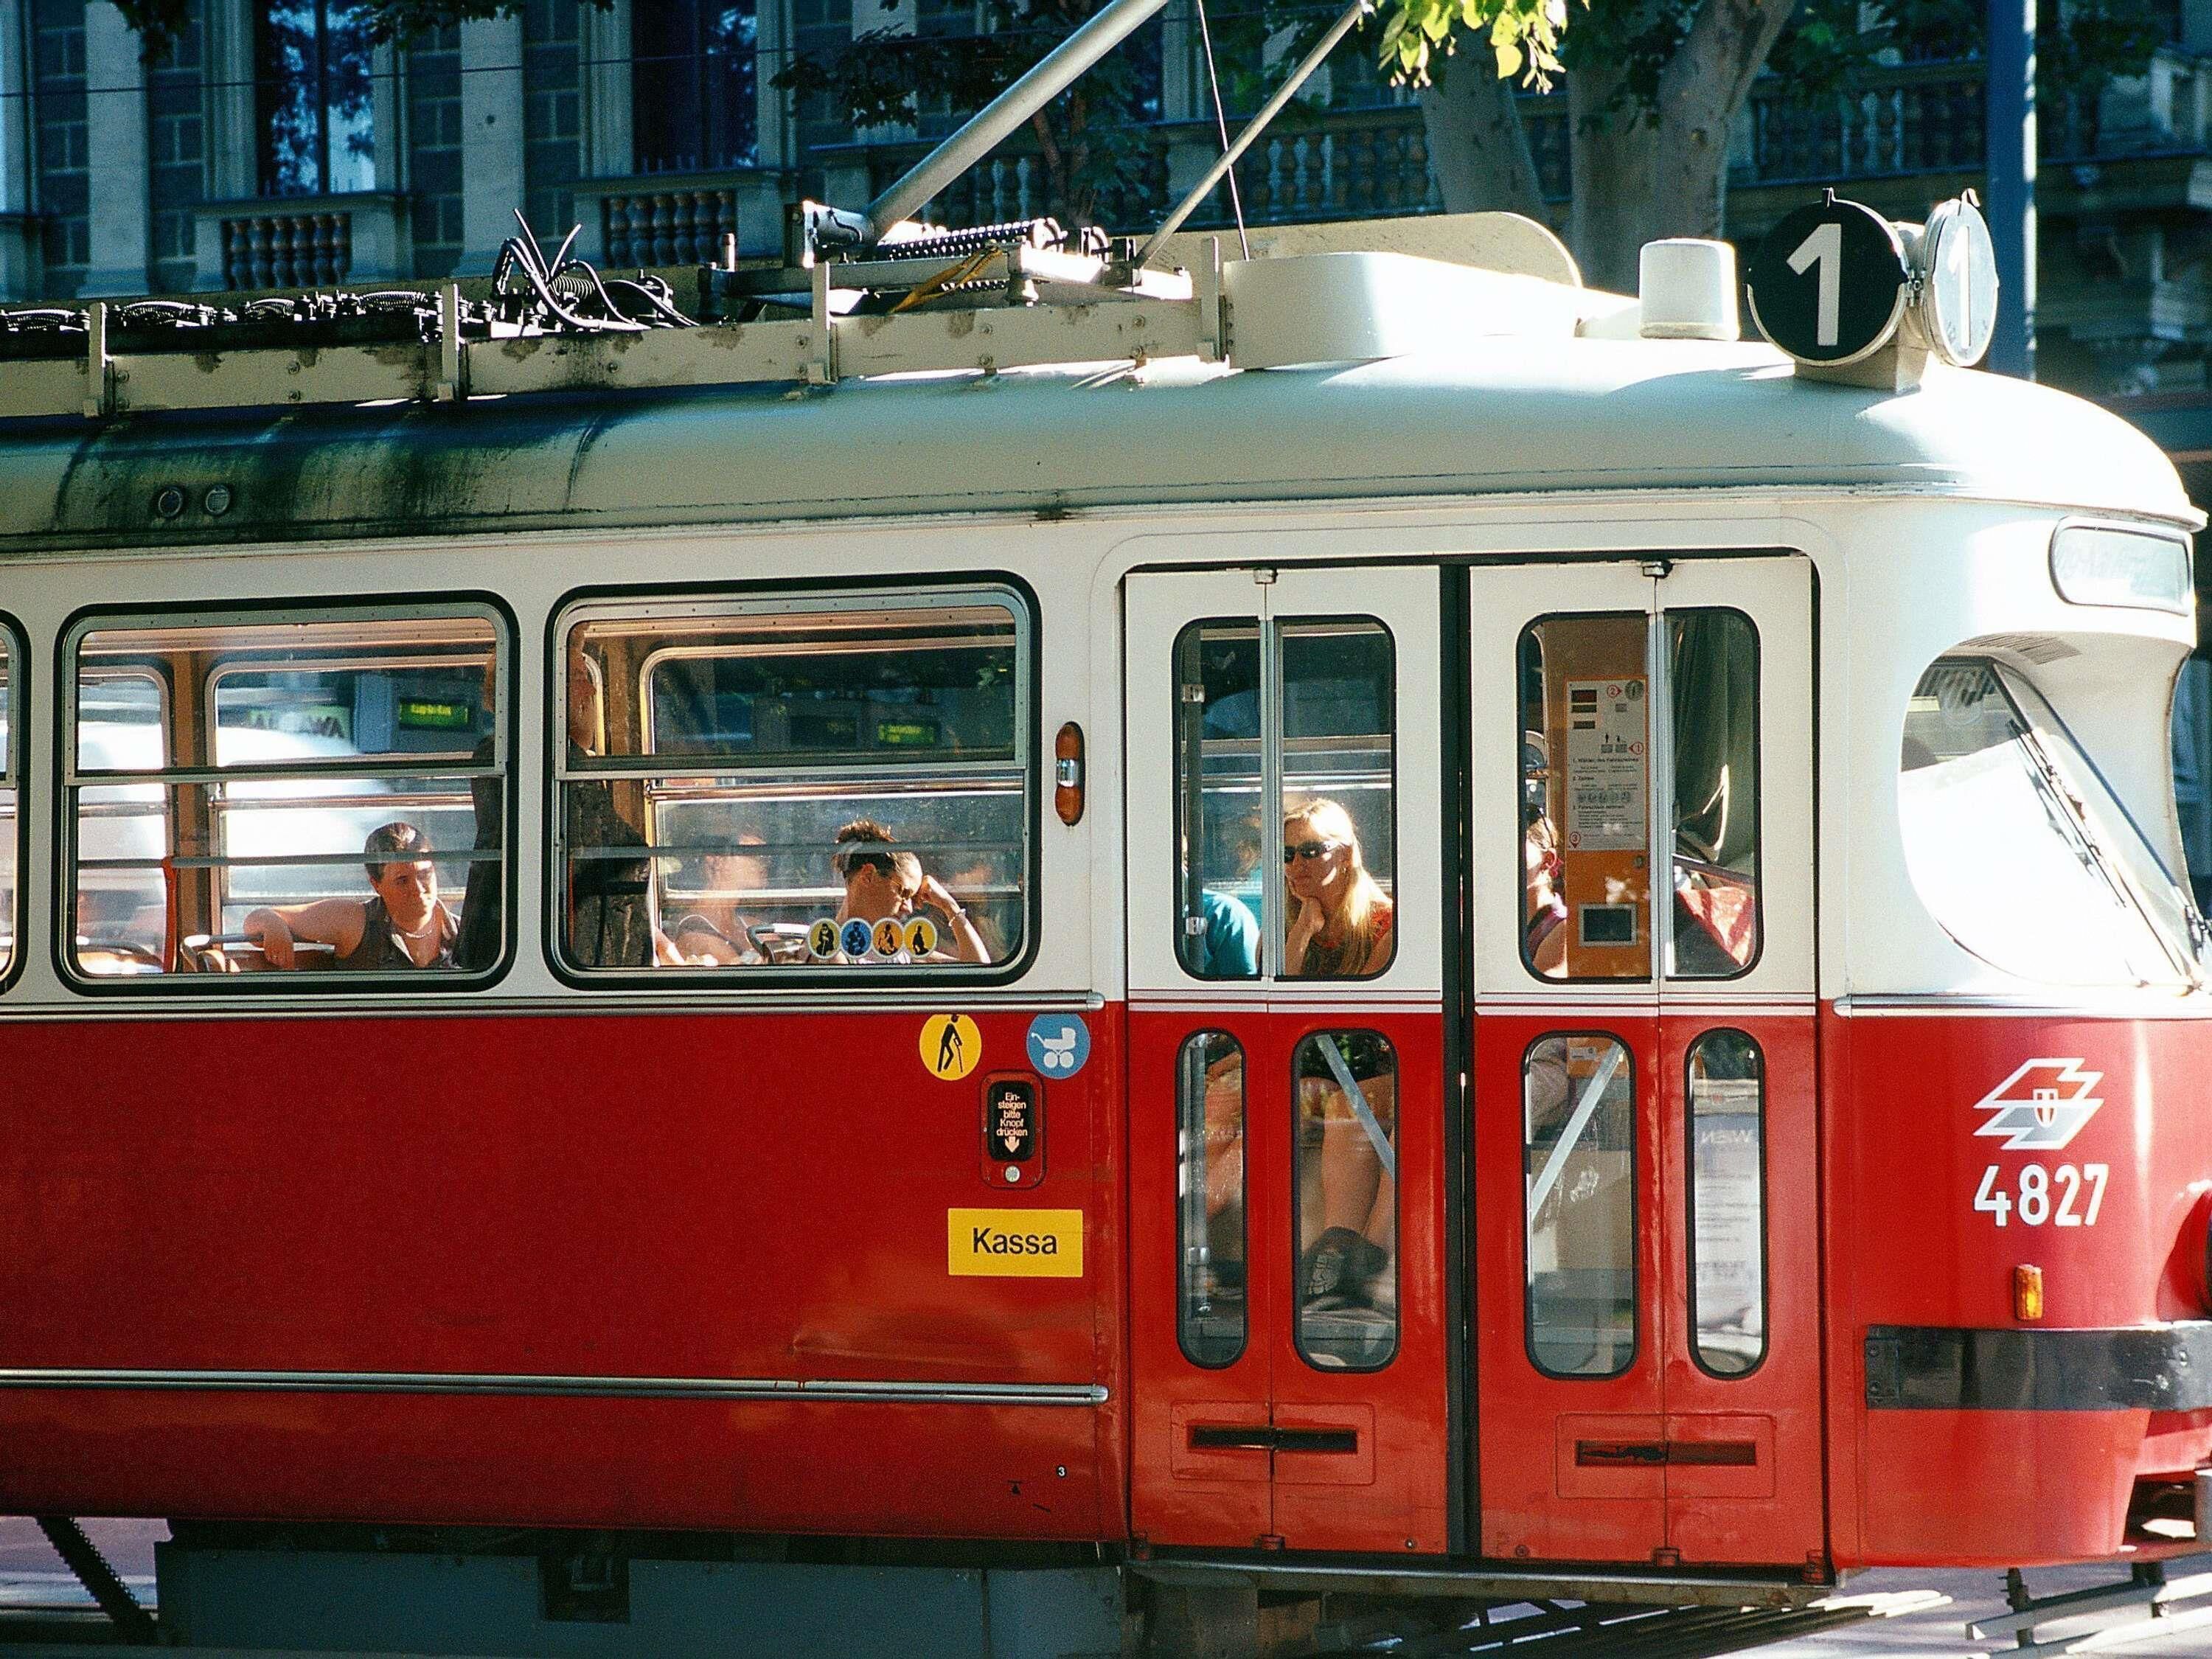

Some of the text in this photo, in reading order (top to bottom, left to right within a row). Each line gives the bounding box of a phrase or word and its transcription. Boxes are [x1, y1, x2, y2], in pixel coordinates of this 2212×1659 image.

[1786, 223, 1842, 347] 1
[1948, 226, 1971, 349] 1
[1005, 1092, 1020, 1101] Ein-
[998, 1101, 1026, 1110] steigen
[1003, 1110, 1020, 1119] bitte
[1000, 1118, 1024, 1128] Knopf
[996, 1127, 1028, 1136] drücken
[1974, 1164, 2109, 1226] 4827
[973, 1227, 1057, 1255] Kassa
[1058, 1466, 1065, 1477] 3
